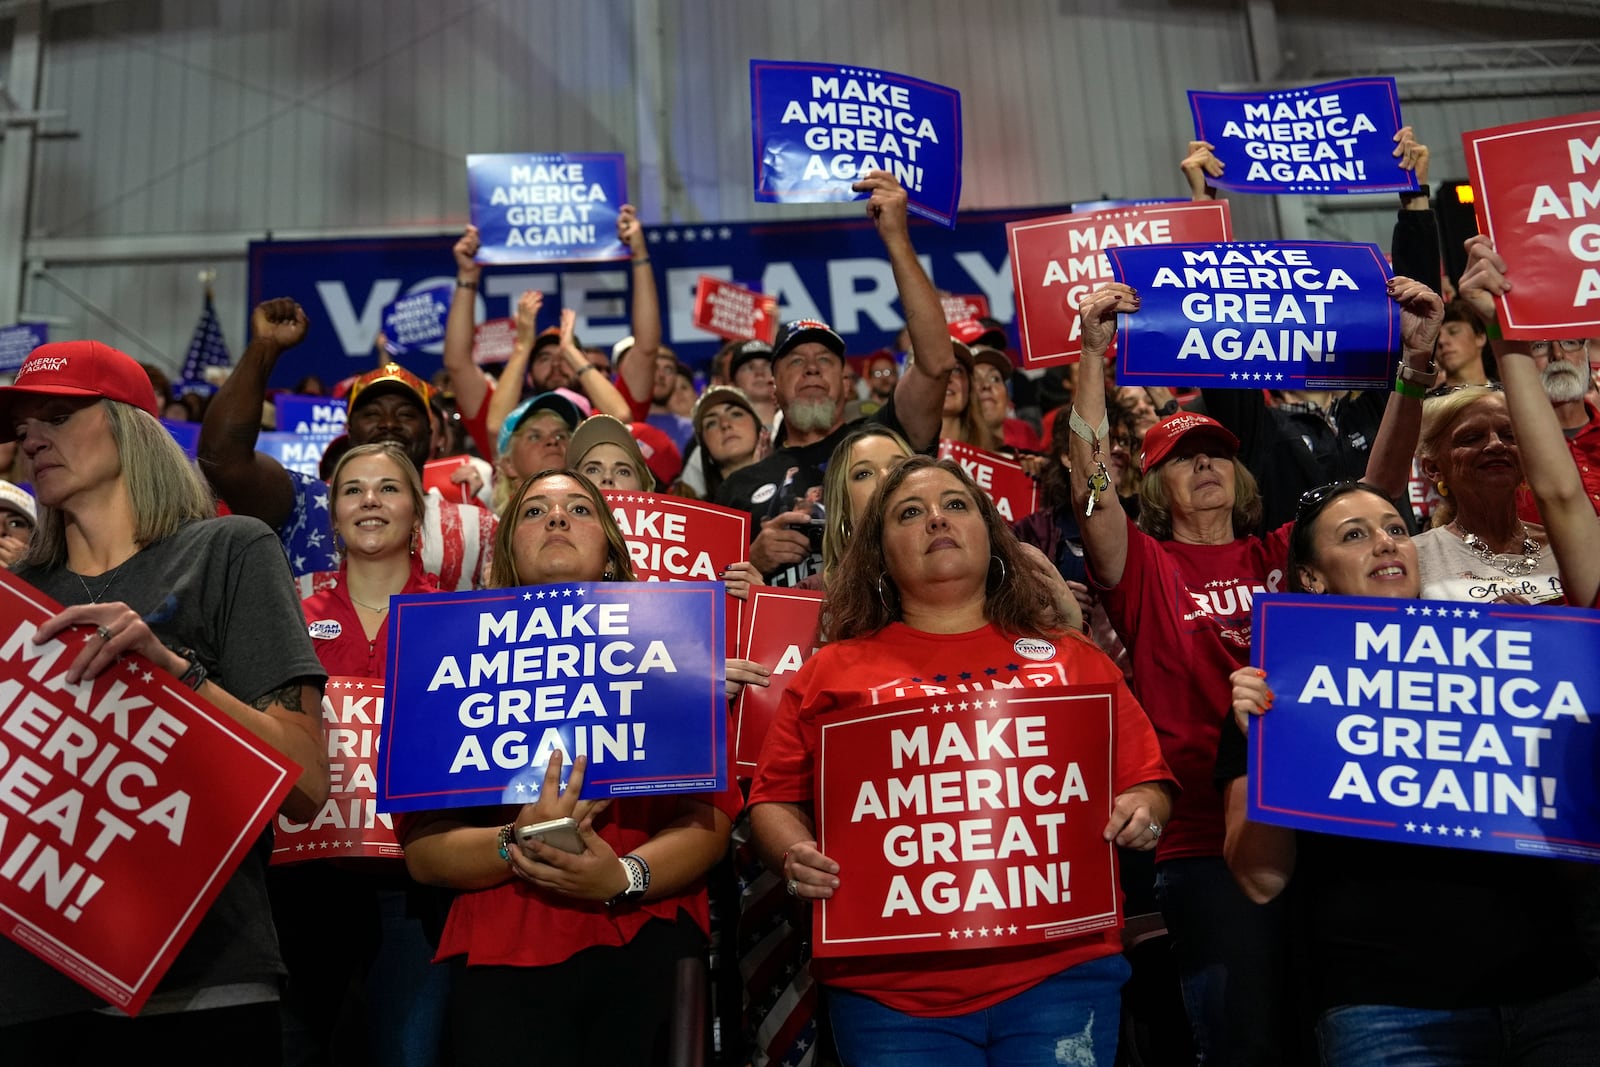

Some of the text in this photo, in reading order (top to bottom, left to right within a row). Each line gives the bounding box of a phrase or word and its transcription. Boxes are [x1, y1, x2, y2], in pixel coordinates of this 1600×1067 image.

[812, 76, 910, 111] MAKE
[1243, 94, 1344, 122] MAKE
[781, 101, 940, 144] AMERICA
[1222, 113, 1378, 141] AMERICA
[804, 126, 922, 161] GREAT
[1244, 137, 1359, 163] GREAT
[510, 163, 585, 184] MAKE
[802, 153, 925, 192] AGAIN!
[1246, 160, 1367, 182] AGAIN!
[489, 183, 607, 206] AMERICA
[506, 205, 594, 226] GREAT
[505, 225, 597, 247] AGAIN!
[1068, 219, 1173, 253] MAKE
[1181, 249, 1314, 267] MAKE
[1151, 267, 1360, 291] AMERICA
[1180, 293, 1335, 325] GREAT
[1176, 328, 1338, 363] AGAIN!
[26, 364, 61, 374] AGAIN
[312, 404, 349, 422] MA
[282, 443, 329, 462] MA
[958, 457, 993, 490] KE
[612, 507, 687, 543] AKE
[625, 540, 718, 581] RICA
[1186, 569, 1283, 616] RUMP
[477, 603, 630, 646] MAKE
[1354, 621, 1534, 671] MAKE
[426, 640, 678, 692] AMERICA
[0, 619, 188, 763] MAKE
[457, 680, 644, 729] GREAT
[1297, 664, 1592, 724] AMERICA
[448, 722, 647, 774] AGAIN!
[890, 714, 1049, 769] MAKE
[1335, 713, 1553, 768] GREAT
[850, 761, 1090, 823] AMERICA
[1328, 761, 1558, 820] AGAIN!
[882, 812, 1067, 868] GREAT
[881, 860, 1072, 918] AGAIN!
